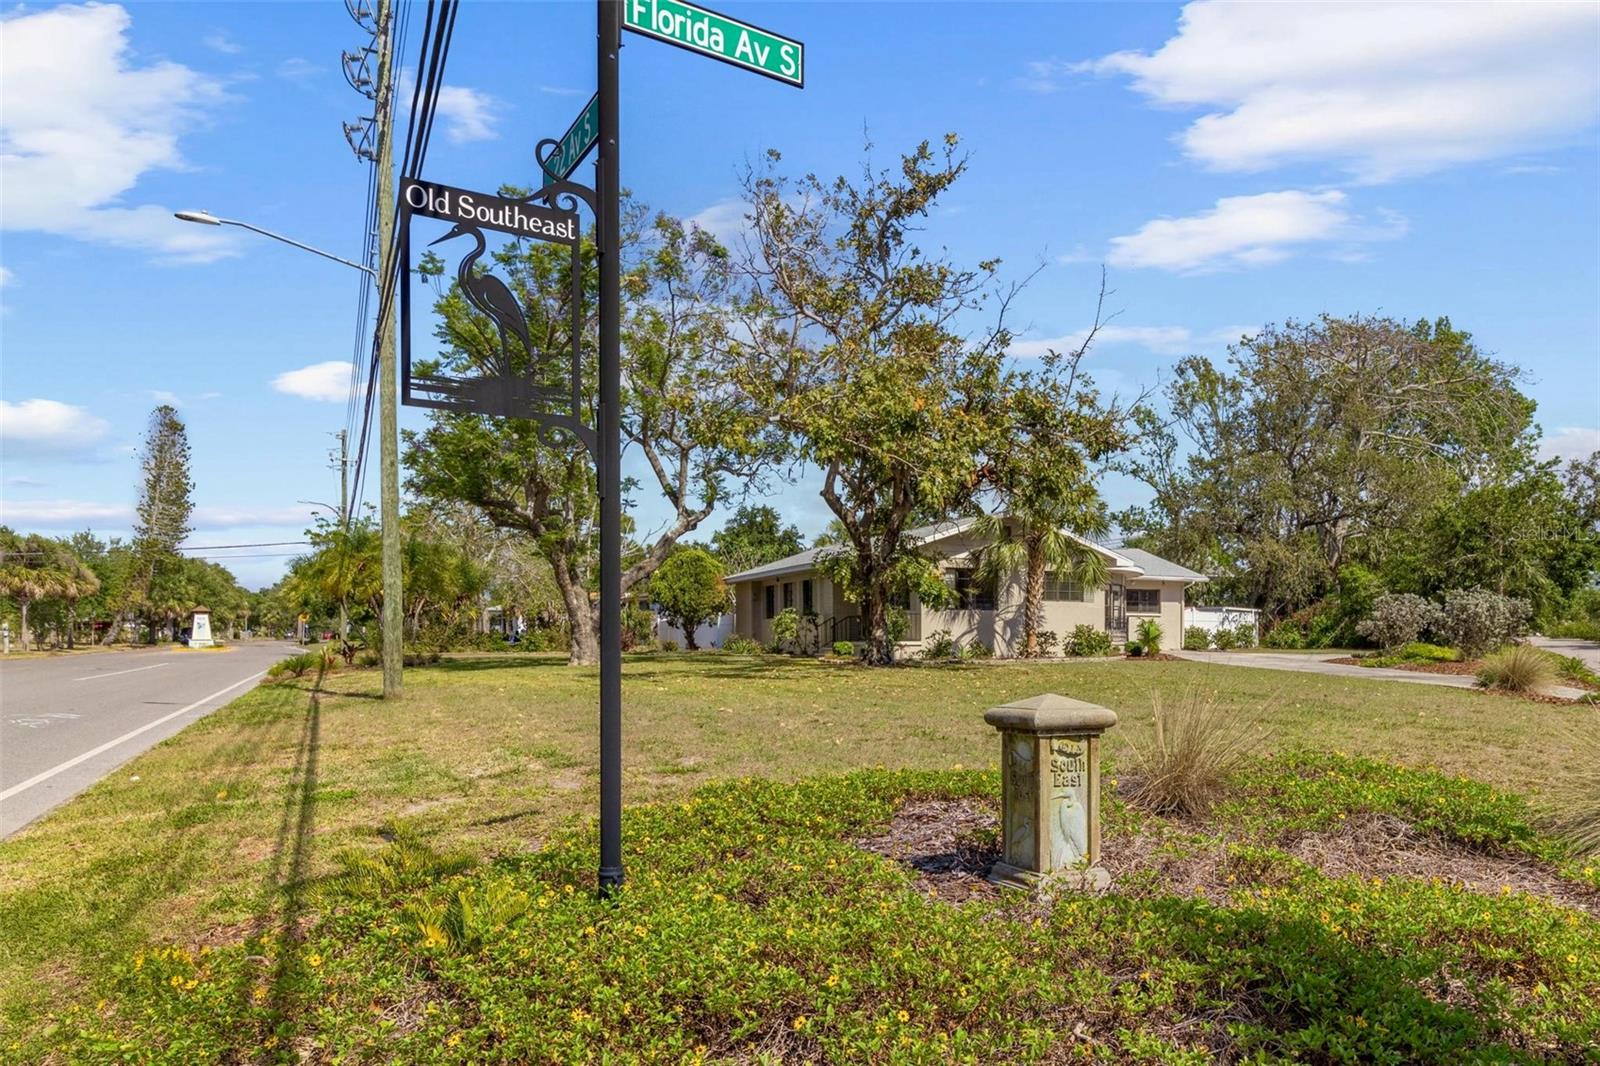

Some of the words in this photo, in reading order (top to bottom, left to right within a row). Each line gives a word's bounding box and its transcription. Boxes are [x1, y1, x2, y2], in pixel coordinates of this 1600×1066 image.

[632, 0, 725, 53] Florida
[734, 30, 770, 67] Av
[779, 44, 796, 76] S
[584, 112, 591, 144] S
[405, 184, 451, 215] Old
[458, 195, 576, 240] Southeast
[1053, 773, 1082, 788] East
